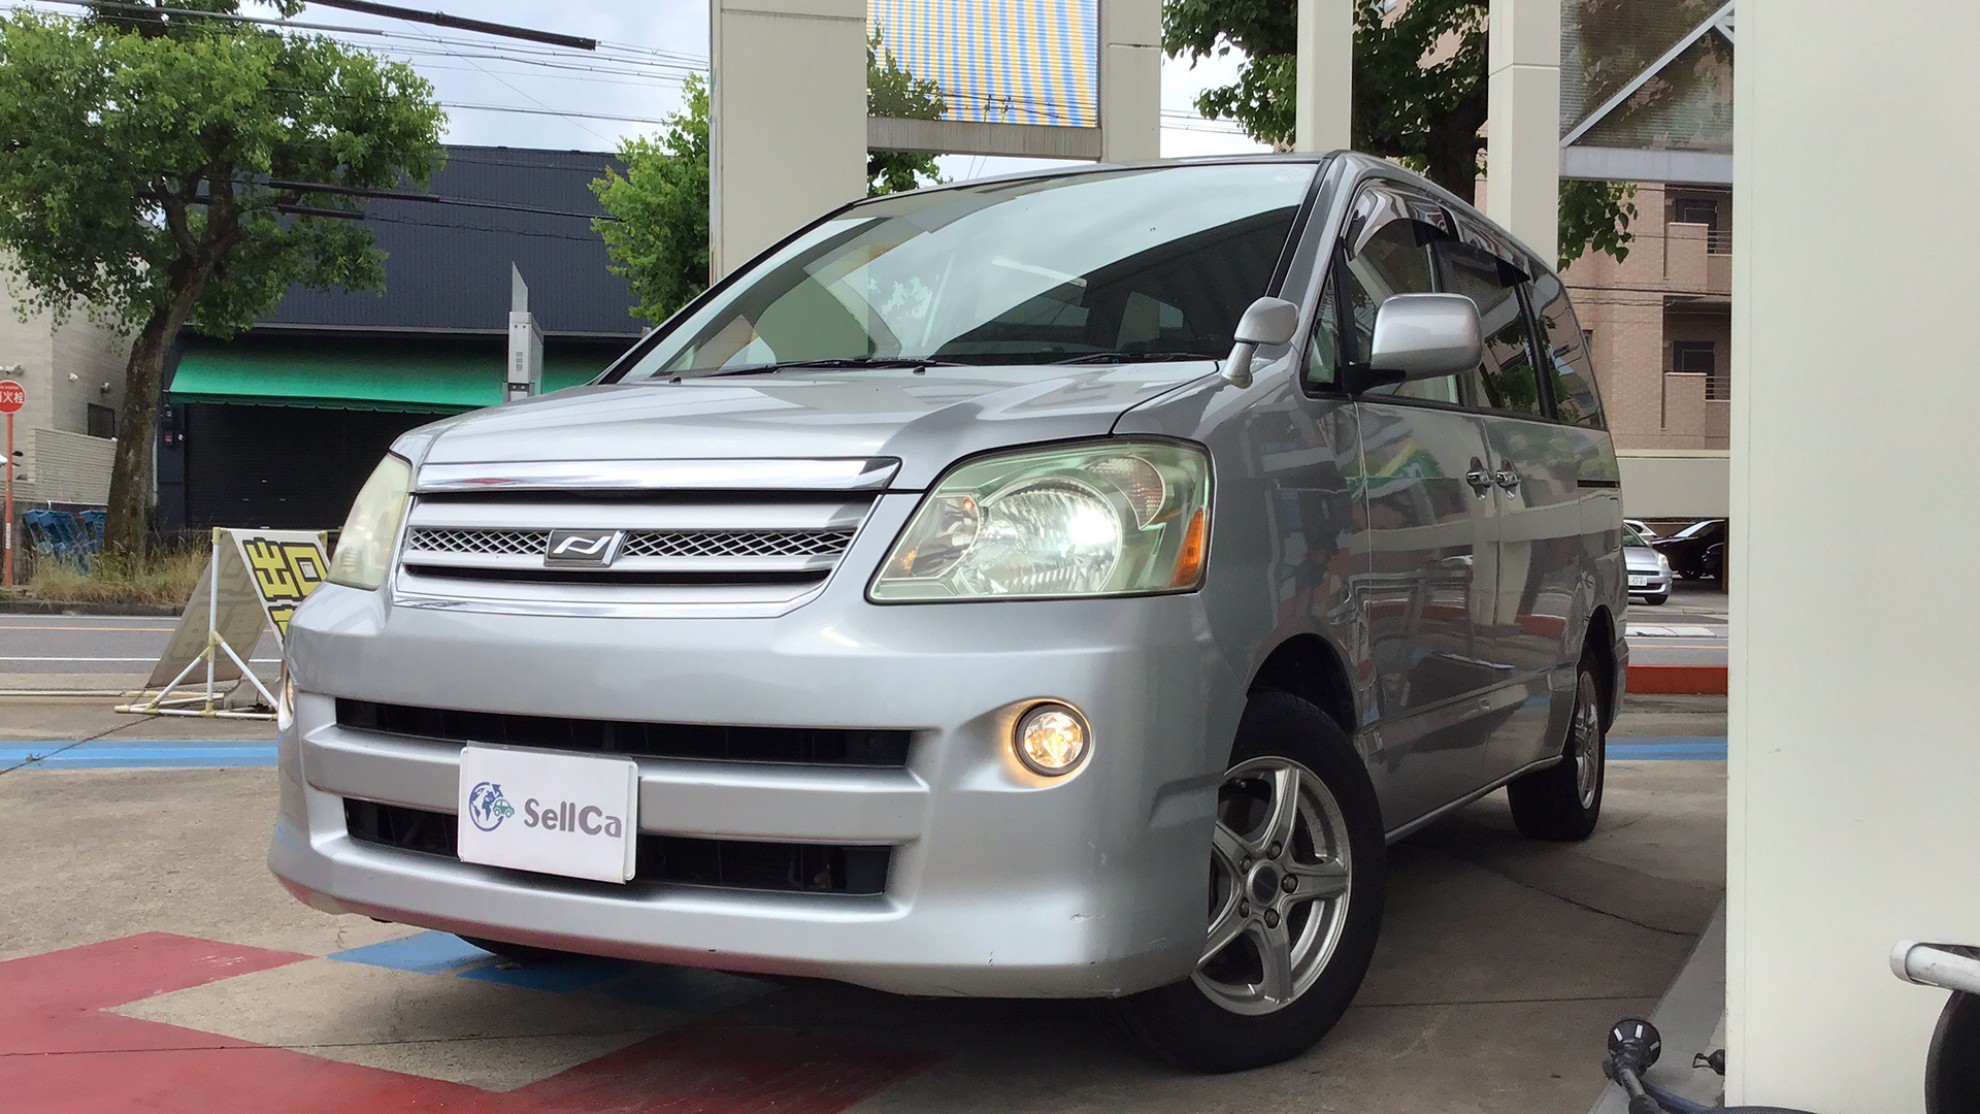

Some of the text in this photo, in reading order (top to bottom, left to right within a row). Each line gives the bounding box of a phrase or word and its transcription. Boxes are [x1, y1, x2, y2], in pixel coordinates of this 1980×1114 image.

[0, 390, 24, 404] 火栓
[242, 537, 329, 602] 出口
[524, 798, 622, 838] SellCa
